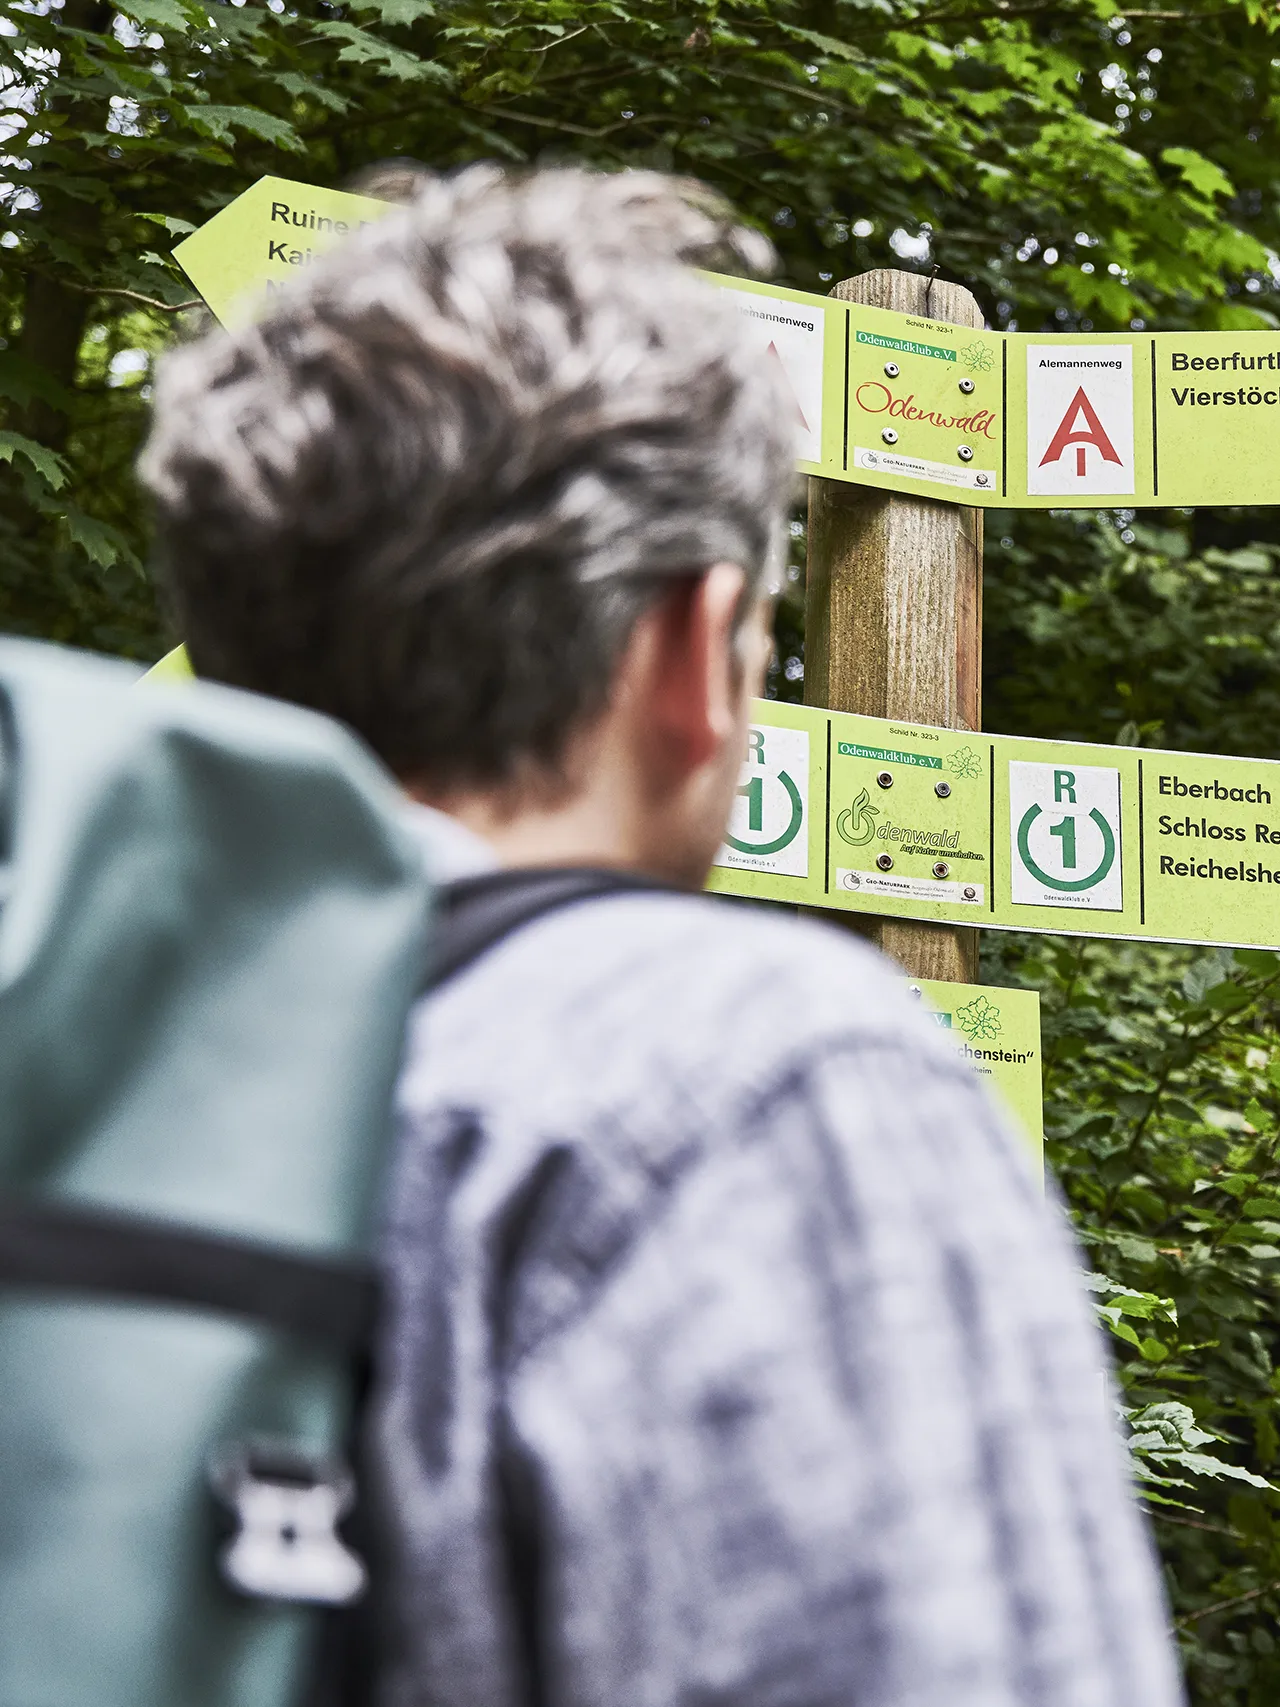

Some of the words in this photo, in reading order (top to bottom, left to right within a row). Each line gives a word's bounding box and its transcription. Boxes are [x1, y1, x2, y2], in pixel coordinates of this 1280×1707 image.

[271, 202, 349, 236] Ruine
[906, 319, 925, 329] Schild
[936, 326, 953, 334] 323-1
[858, 332, 932, 356] Odenwaldklub
[934, 350, 953, 361] e.V.
[1039, 360, 1123, 370] Alemannenweg
[855, 381, 997, 440] Odenwald
[889, 727, 909, 737] Schild
[921, 732, 939, 741] 323-3
[840, 744, 917, 764] Odenwaldklub
[919, 758, 939, 768] e.V.
[1053, 770, 1077, 803] R
[1158, 775, 1271, 804] Eberbach
[1050, 816, 1076, 869] 1
[1158, 815, 1247, 842] Schloss
[900, 844, 917, 855] Auf
[916, 846, 938, 857] Natur
